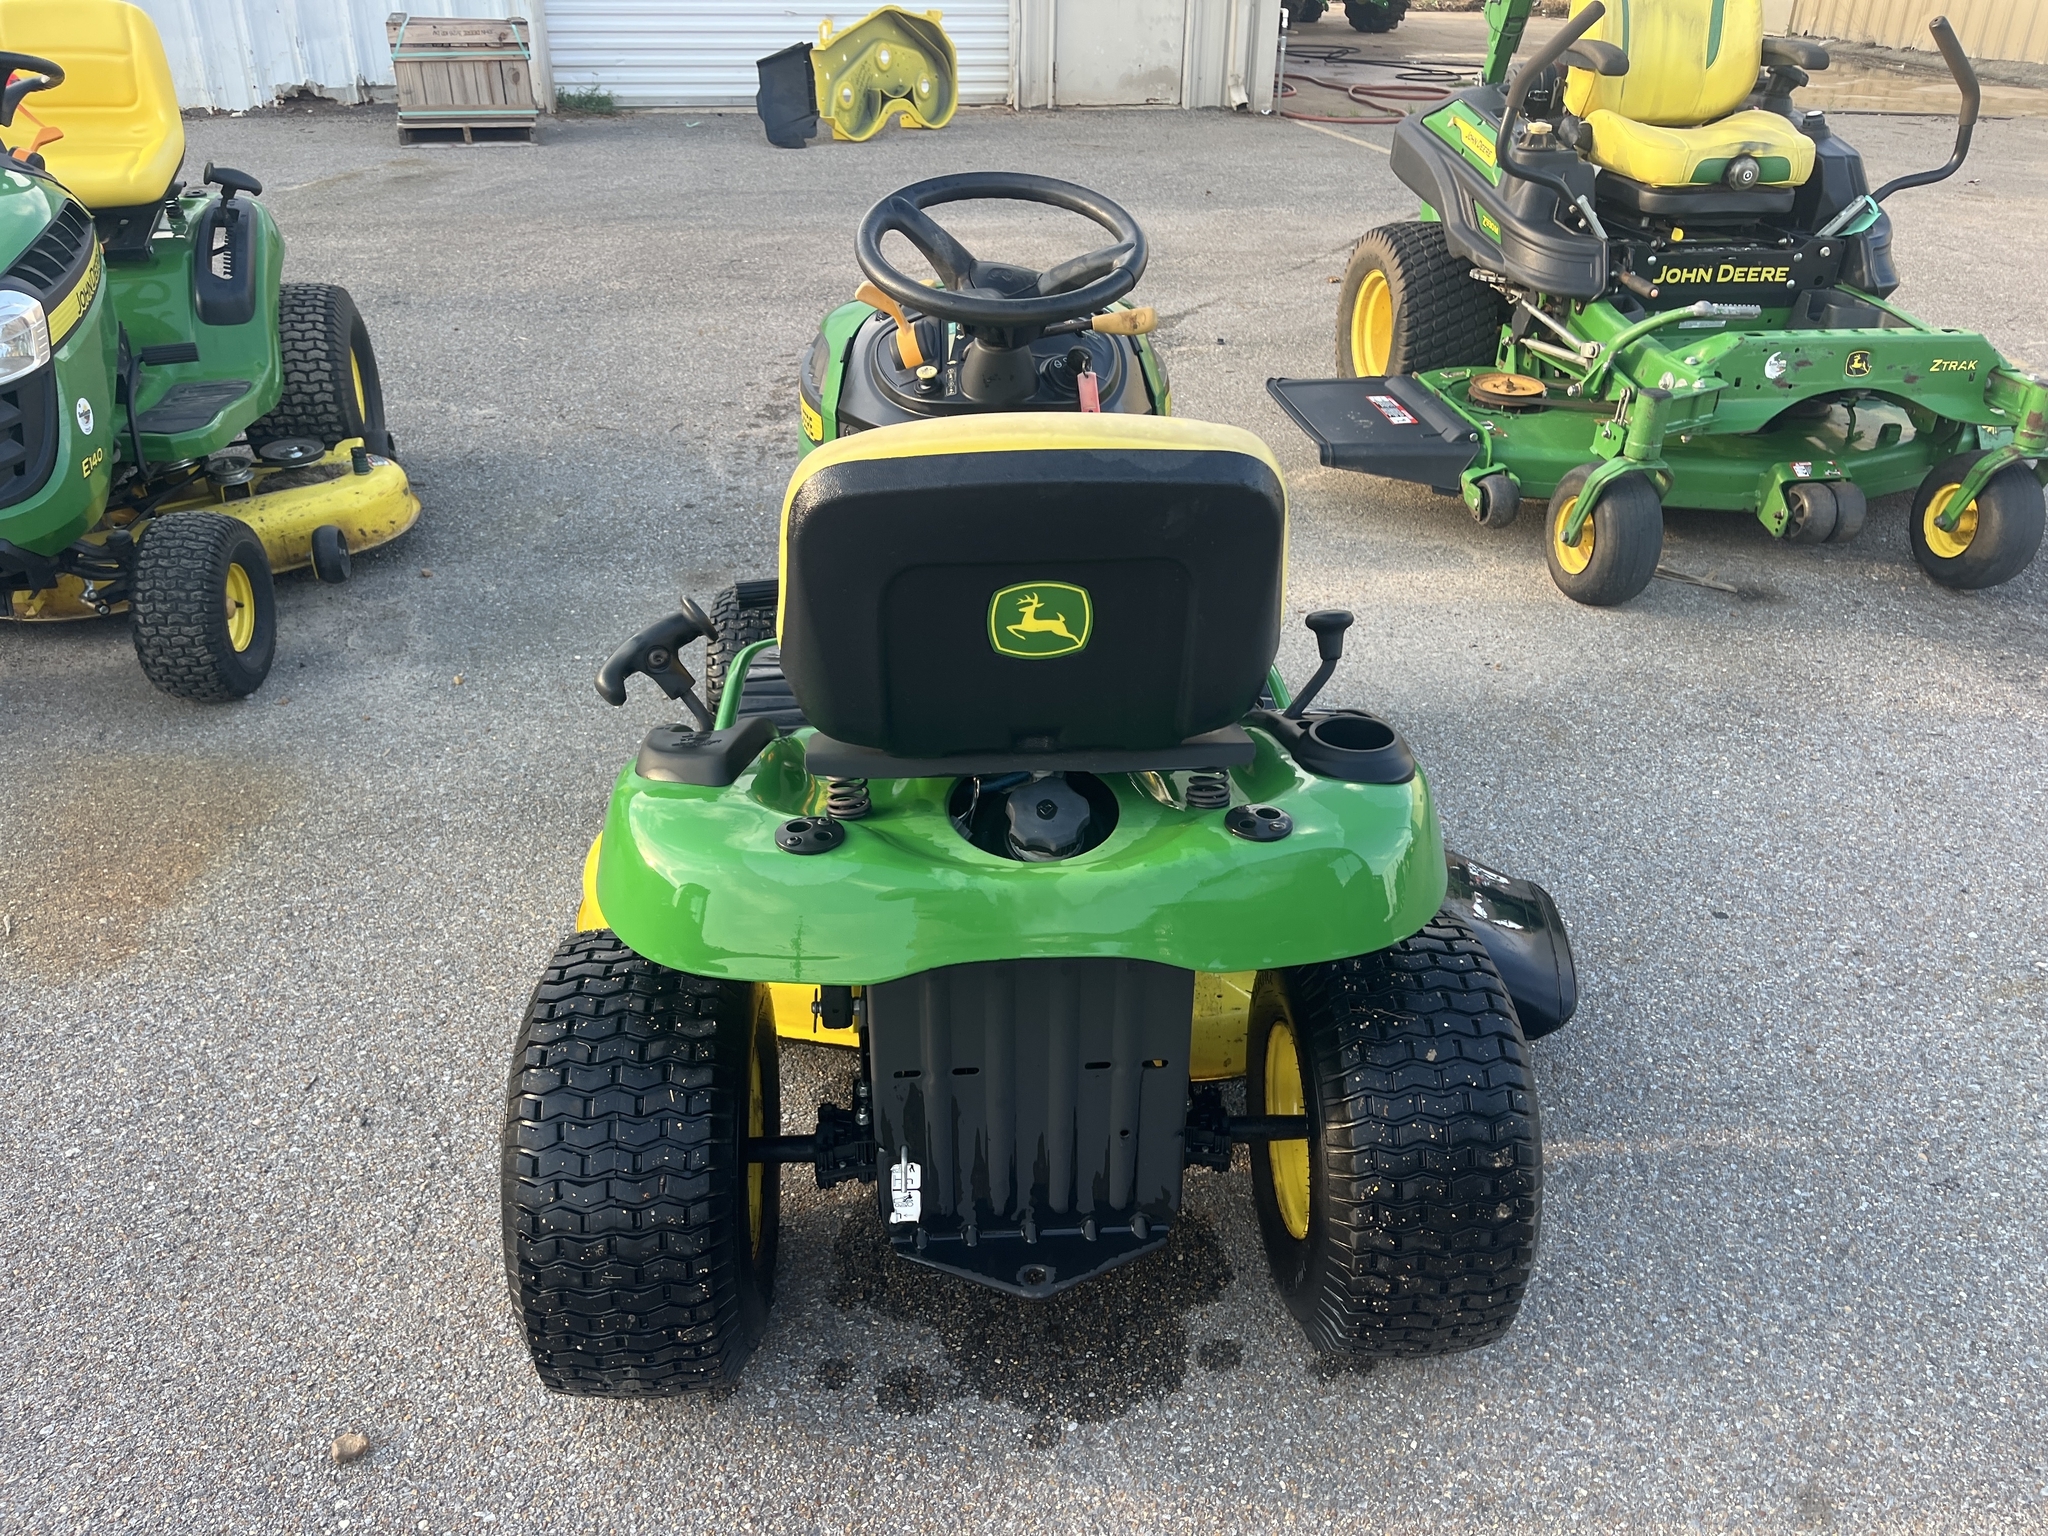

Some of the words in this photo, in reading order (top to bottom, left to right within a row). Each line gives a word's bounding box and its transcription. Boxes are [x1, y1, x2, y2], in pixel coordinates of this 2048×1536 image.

[1465, 131, 1478, 147] JOHN
[1478, 139, 1493, 158] DEERE
[1652, 265, 1713, 284] JOHN
[1716, 264, 1790, 283] DEERE
[1929, 359, 1979, 372] ZTRAK
[81, 447, 103, 478] E140
